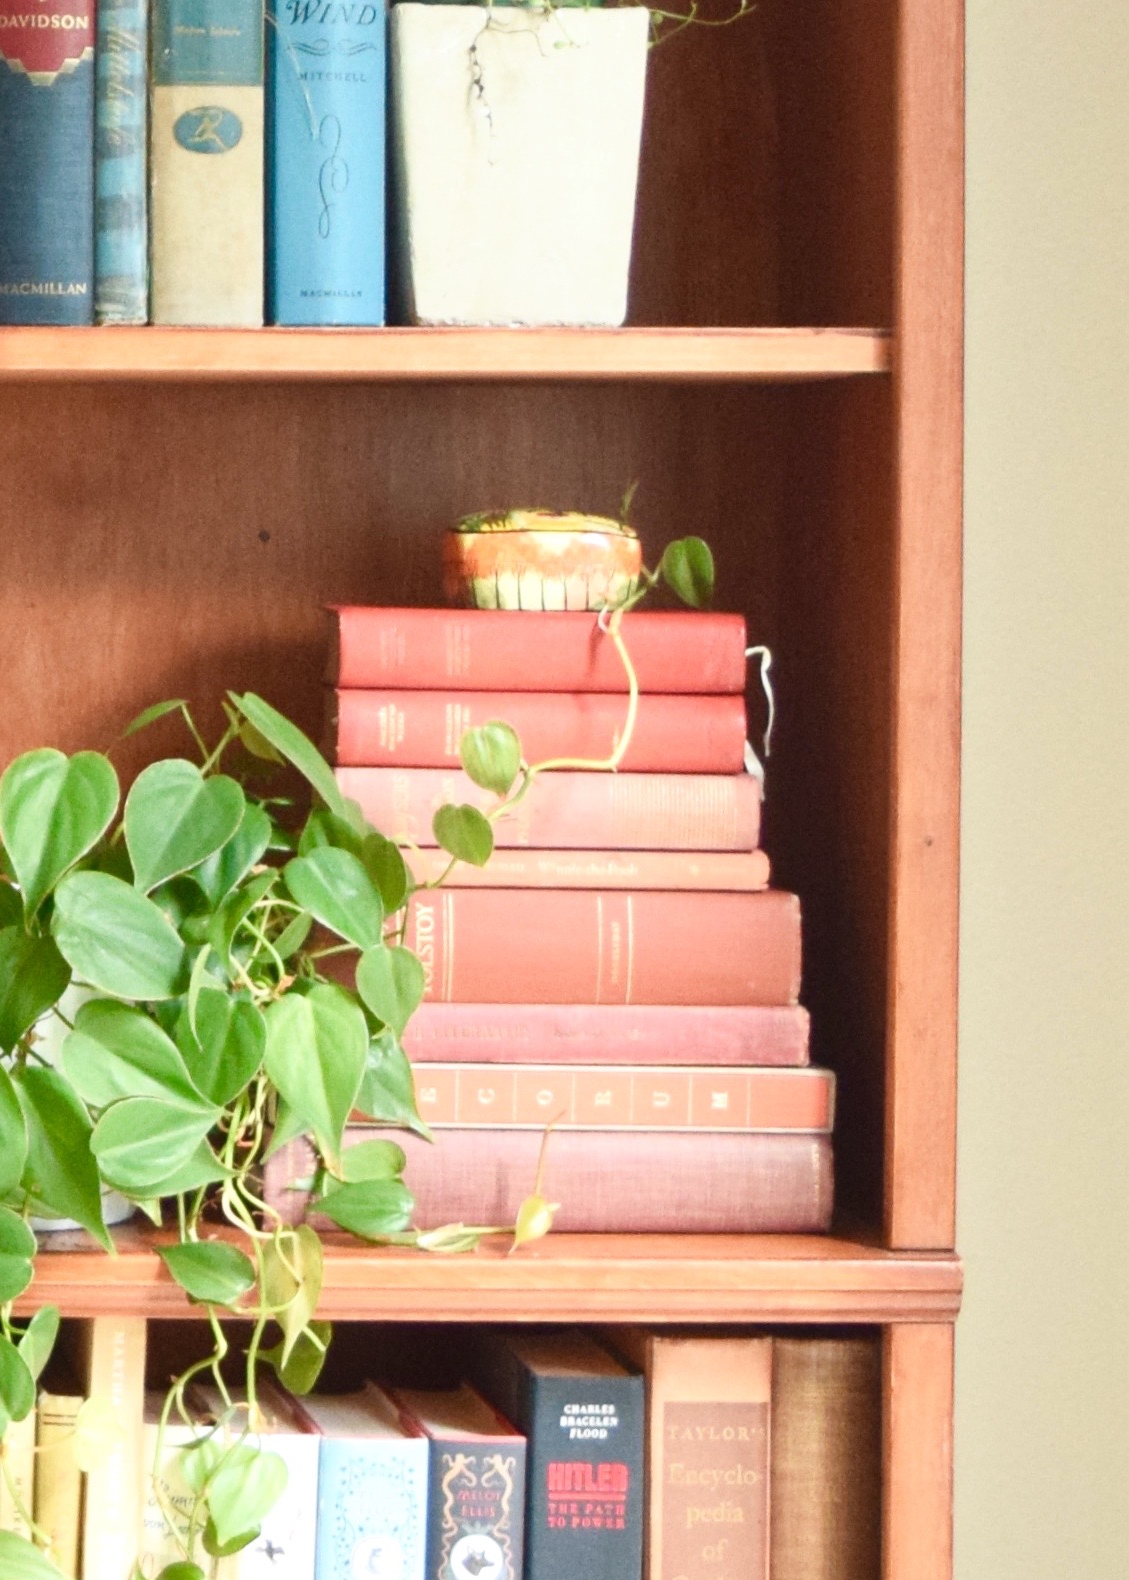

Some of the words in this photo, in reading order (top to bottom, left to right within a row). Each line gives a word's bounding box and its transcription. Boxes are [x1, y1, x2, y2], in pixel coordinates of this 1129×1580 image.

[286, 0, 377, 26] WIND
[299, 71, 368, 83] MITCHELL
[562, 1403, 616, 1415] CHARLES
[559, 1416, 619, 1428] BRACELEN
[568, 1428, 608, 1440] FLOOD
[547, 1462, 628, 1492] HITLER
[548, 1503, 579, 1515] THE
[585, 1503, 626, 1516] PATH
[685, 1502, 745, 1529] pedia
[548, 1516, 566, 1528] TO
[571, 1516, 626, 1529] POWER
[701, 1537, 729, 1561] of
